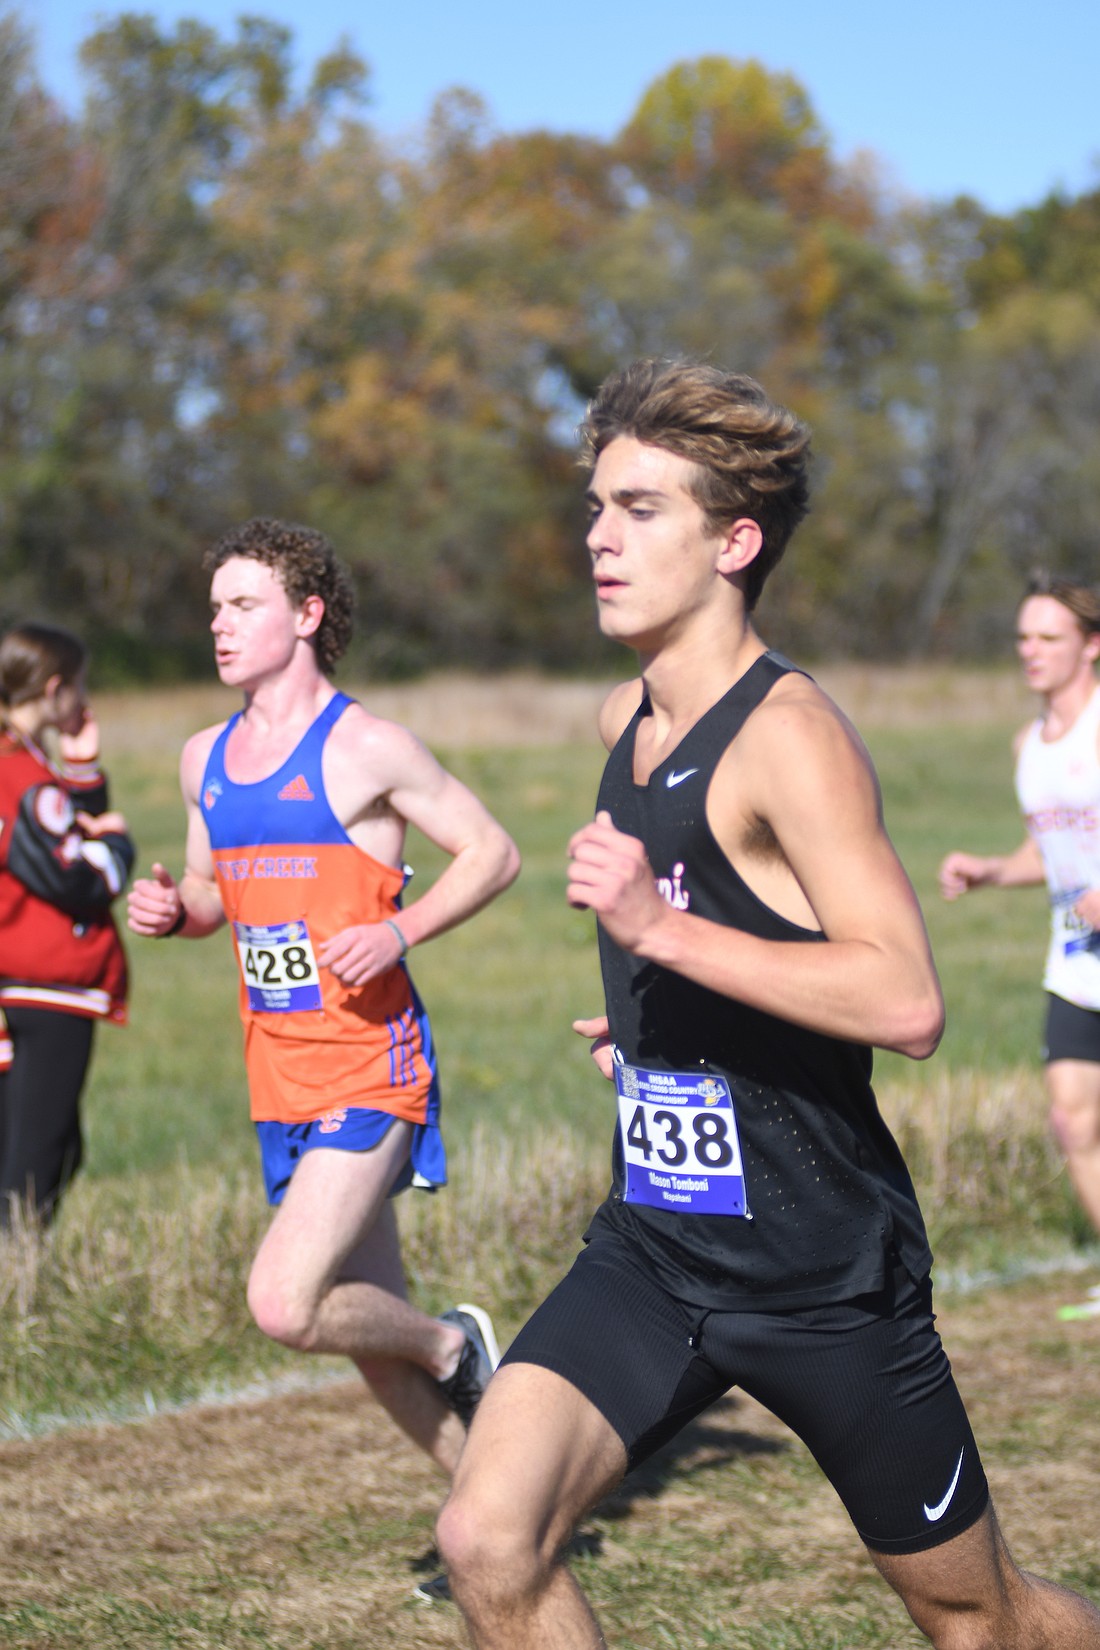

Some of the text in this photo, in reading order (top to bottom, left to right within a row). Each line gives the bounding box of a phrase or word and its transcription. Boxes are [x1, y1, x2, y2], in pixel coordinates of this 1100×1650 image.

[253, 856, 319, 879] CREEK
[245, 946, 312, 983] 428
[627, 1105, 733, 1168] 438
[671, 1176, 708, 1191] Tomboni
